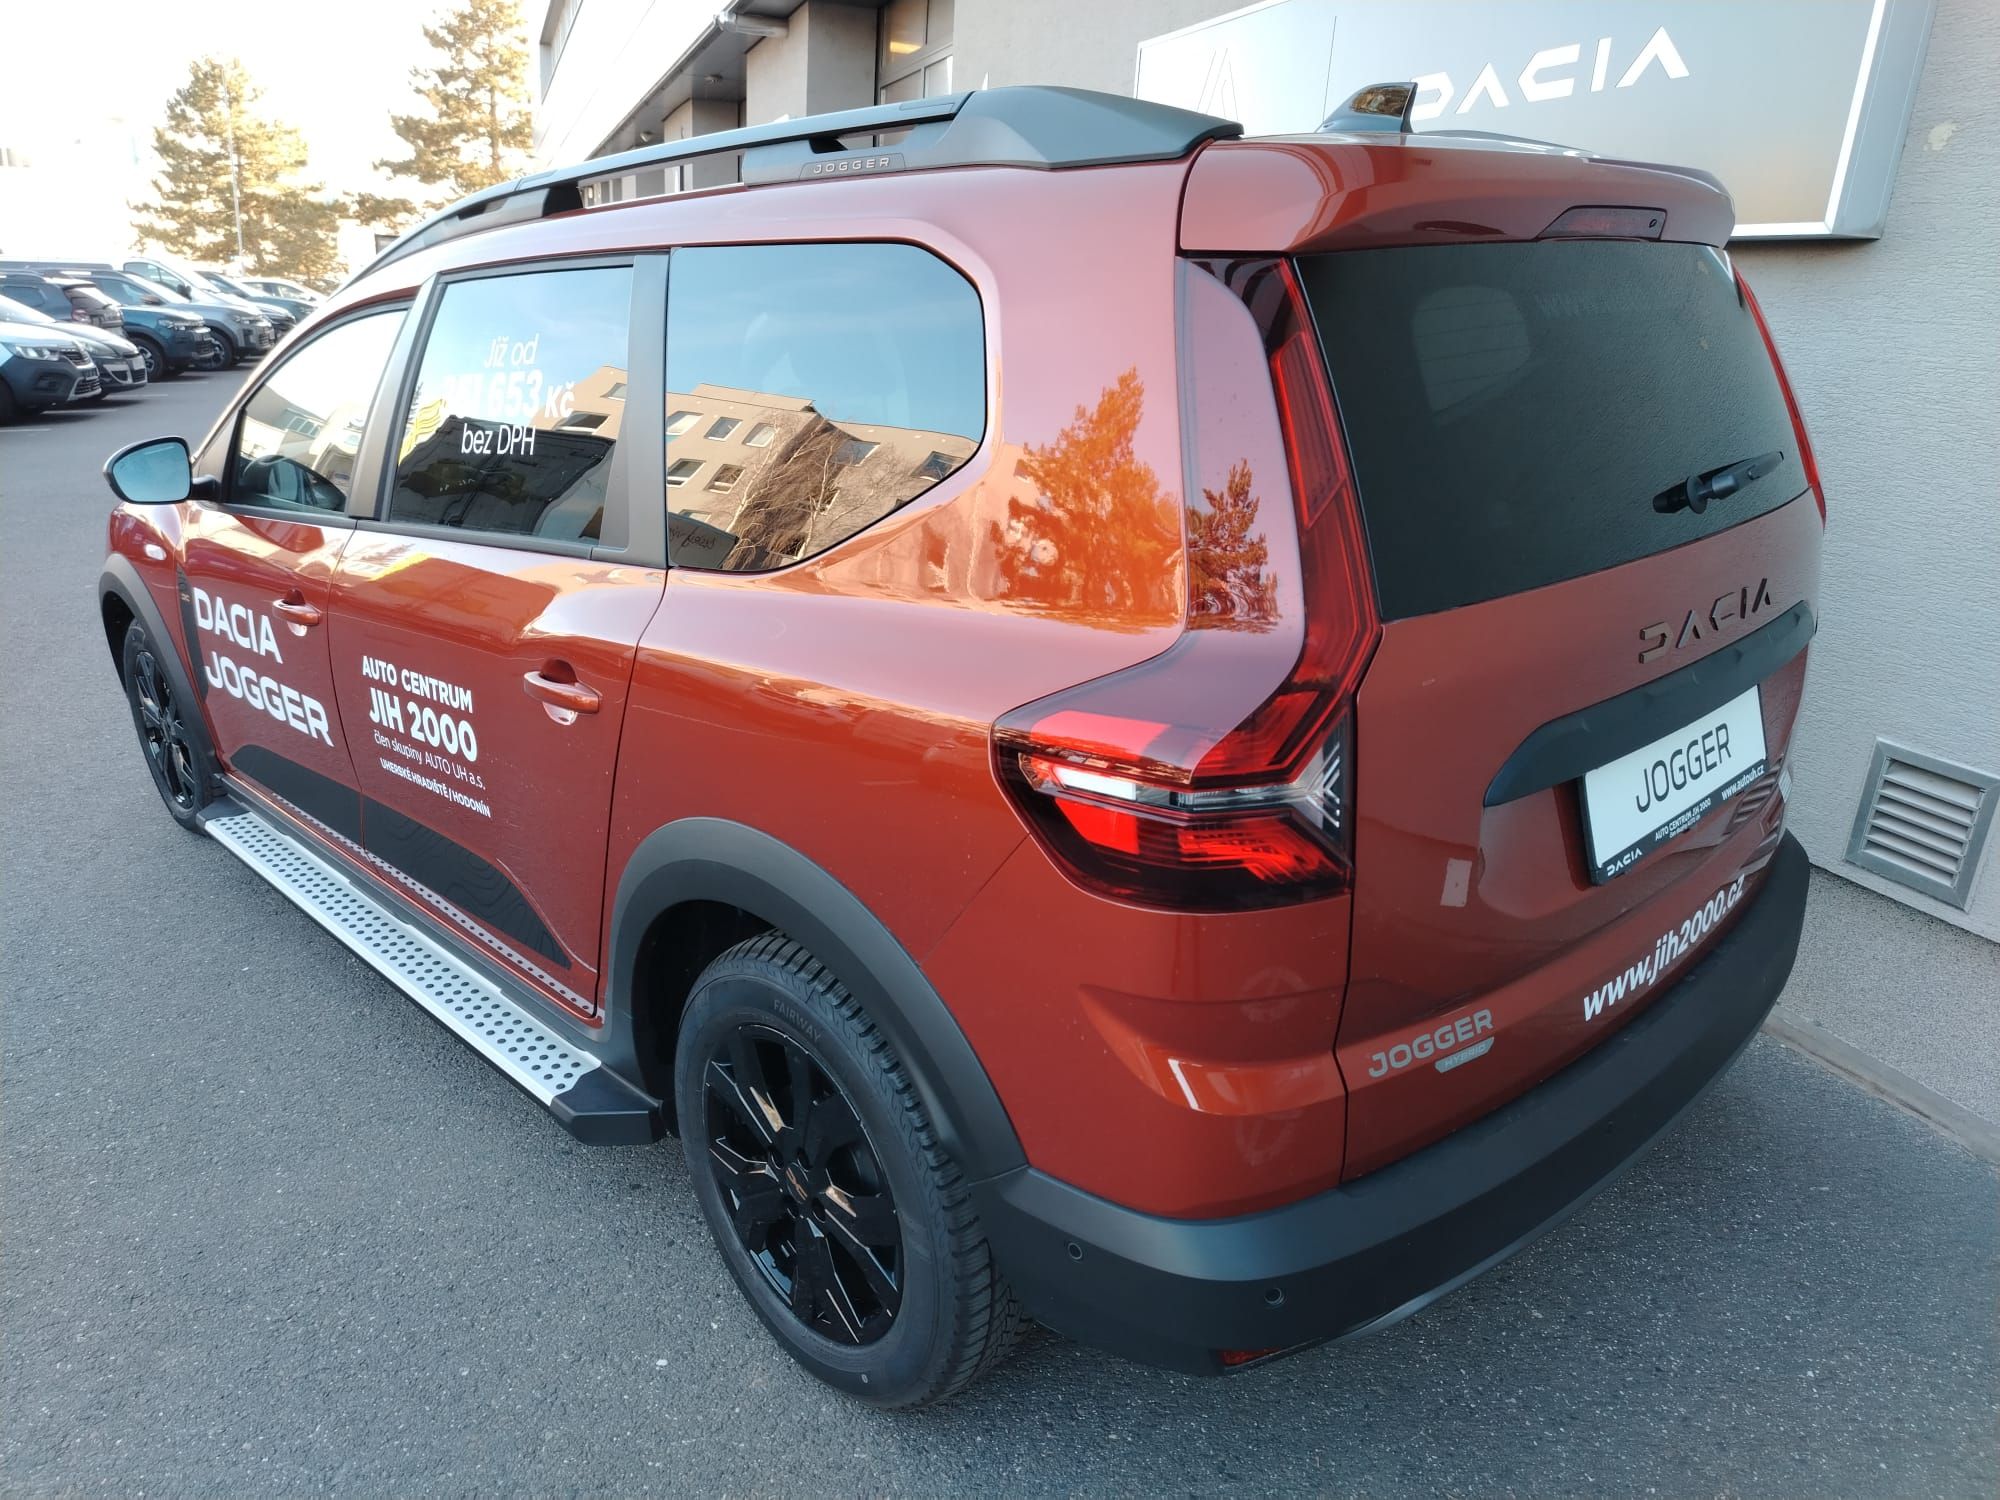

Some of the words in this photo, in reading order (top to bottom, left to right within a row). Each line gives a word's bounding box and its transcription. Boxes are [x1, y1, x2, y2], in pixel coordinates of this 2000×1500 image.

[1409, 25, 1690, 121] DACIA
[813, 157, 890, 174] JOGGER
[484, 335, 510, 368] Již
[511, 333, 540, 366] od
[544, 381, 576, 418] Kč
[461, 422, 492, 455] bez
[496, 424, 537, 456] DPH
[193, 587, 283, 664] DACIA
[1638, 578, 1771, 664] DACIA
[204, 651, 335, 747] JOGGER
[362, 655, 398, 686] AUTO
[401, 668, 473, 713] CENTRUM
[369, 687, 405, 734] JIH
[406, 701, 478, 762] 2000
[380, 757, 411, 782] UHERSKÉ
[452, 790, 491, 818] HODONÍN
[392, 737, 423, 765] skupiny
[425, 751, 451, 775] AUTO
[452, 761, 468, 781] UH
[469, 771, 486, 790] a.s.
[1636, 722, 1732, 813] JOGGER
[1607, 848, 1643, 877] DACIA
[1583, 874, 1745, 1022] www.jih2000.cz
[773, 999, 821, 1042] FAIRWAY
[1368, 1008, 1494, 1078] JOGGER
